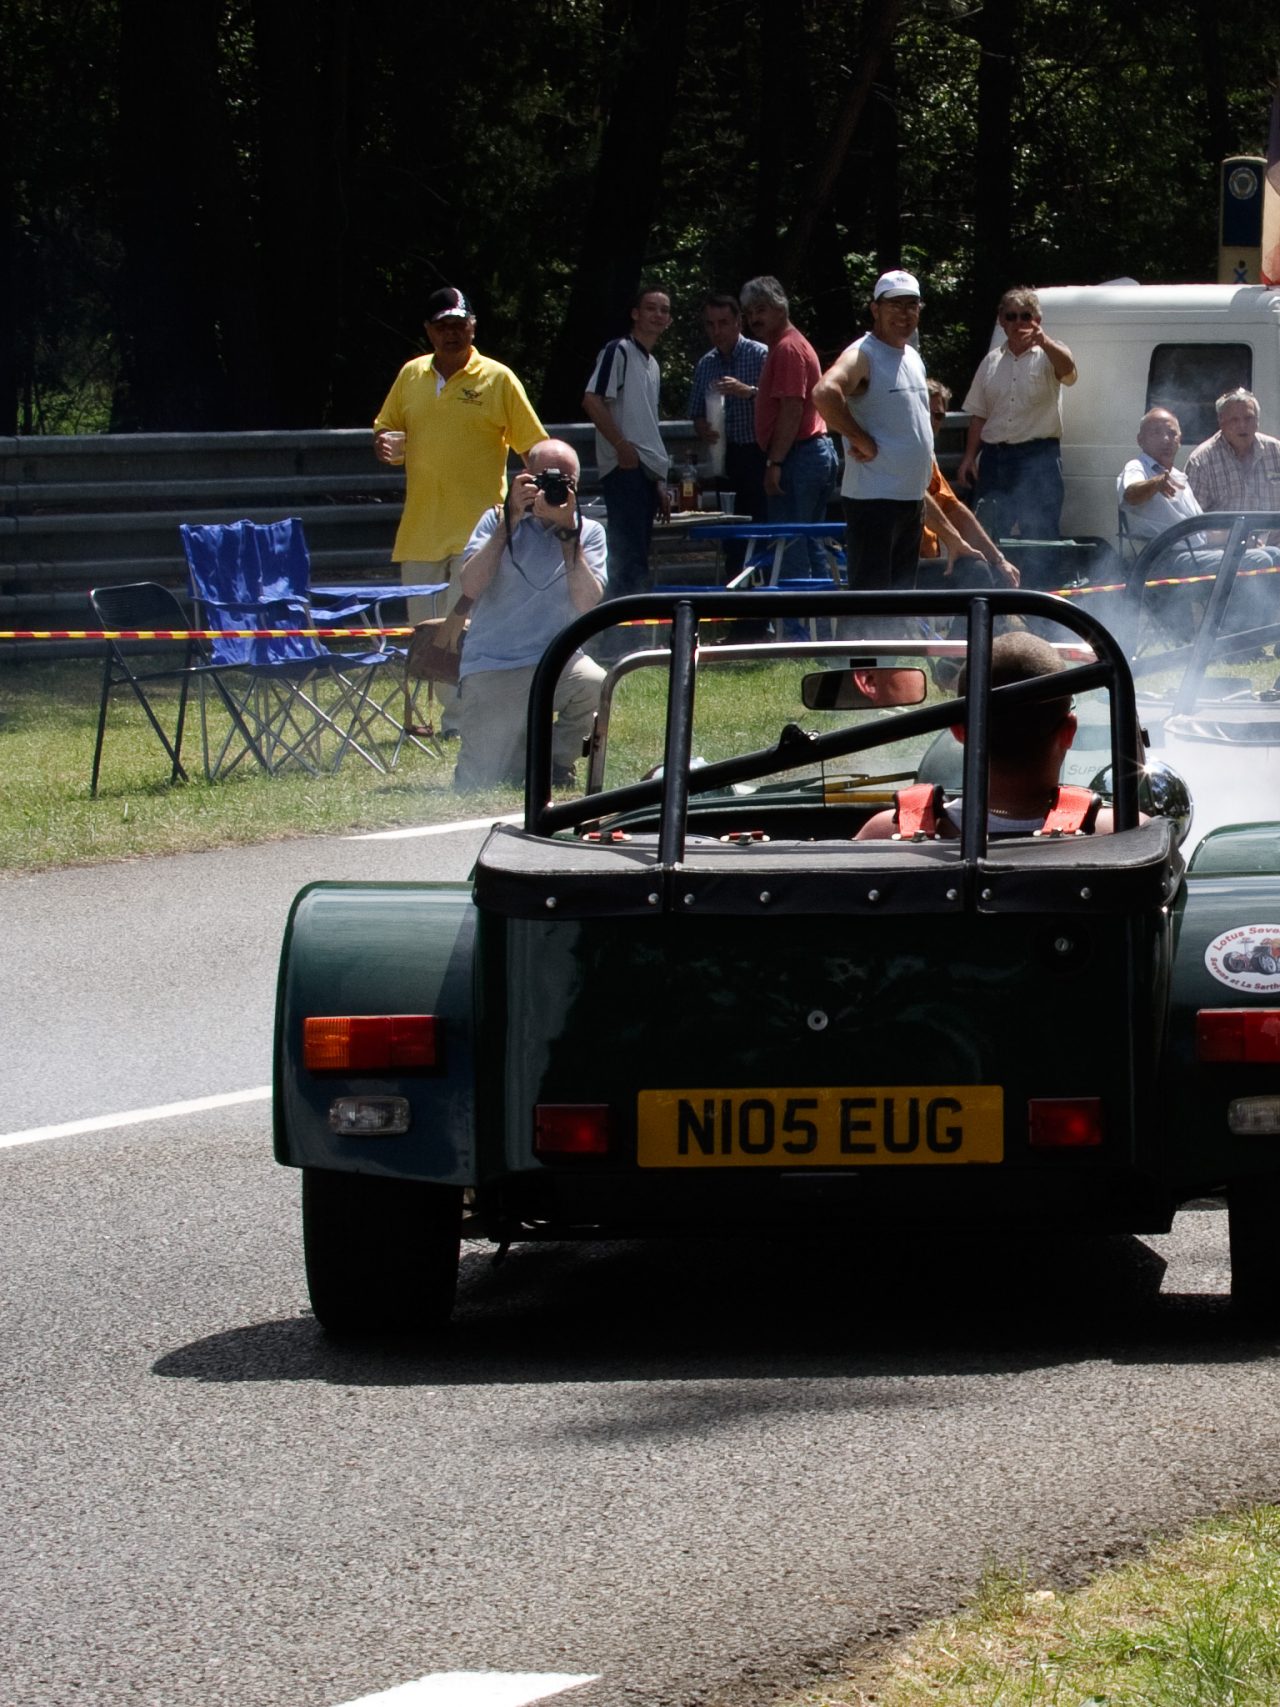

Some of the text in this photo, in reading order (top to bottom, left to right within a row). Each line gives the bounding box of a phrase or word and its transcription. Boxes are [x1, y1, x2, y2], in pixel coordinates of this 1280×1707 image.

[1212, 931, 1245, 951] Lotus
[1210, 957, 1229, 980] Sevens
[677, 1097, 964, 1156] N105 EUG
